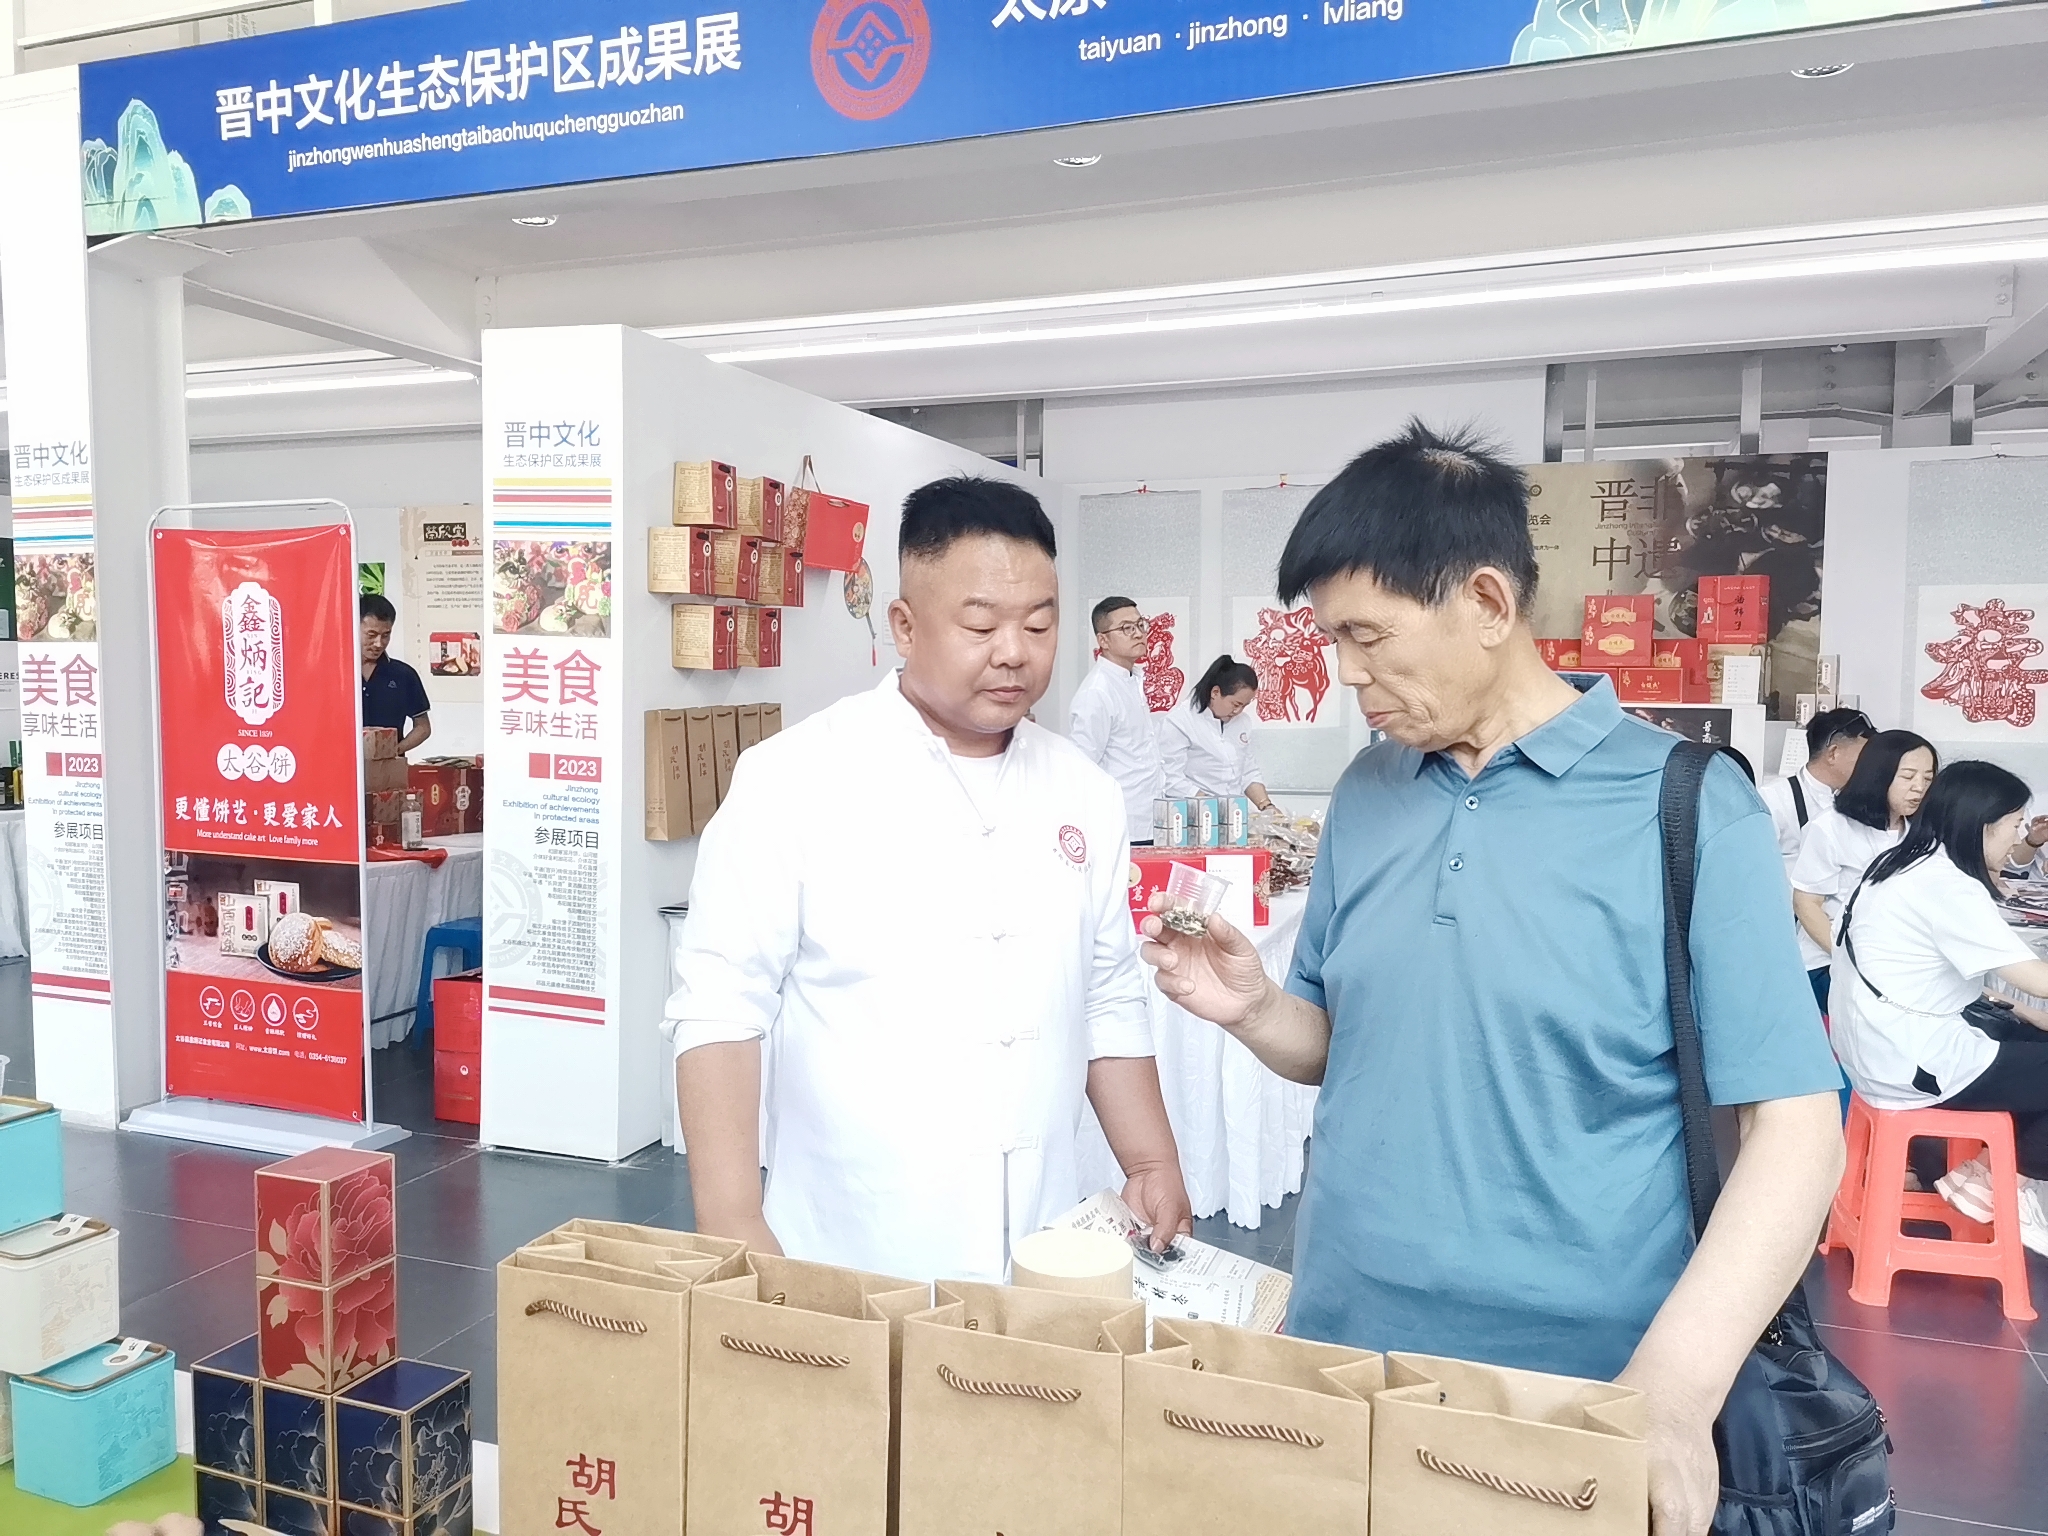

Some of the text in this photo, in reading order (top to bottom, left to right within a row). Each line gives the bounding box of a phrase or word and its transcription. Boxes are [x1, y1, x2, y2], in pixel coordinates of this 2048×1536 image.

[1079, 31, 1161, 62] taiyuan
[1186, 13, 1288, 50] jinzhong
[215, 12, 743, 141] 晋中文化生态保护区成果展
[287, 103, 685, 172] jinzhongwenhuashengtaibaohuquchengguozhan
[504, 420, 601, 448] 晋中文化
[14, 440, 89, 469] 晋中文化
[503, 453, 602, 468] 生态保护区成果展
[14, 471, 90, 487] 生态保护区成果展
[22, 654, 98, 707] 美食
[502, 647, 602, 706] 美食
[22, 711, 98, 739] 享味生活
[237, 729, 258, 737] SINCE
[500, 708, 598, 740] 享味生活
[68, 757, 99, 773] 2023
[222, 749, 291, 776] 太谷饼
[558, 759, 597, 776] 2023
[80, 792, 103, 800] ecology
[565, 785, 599, 795] Jinzhong
[571, 796, 601, 805] ecology
[502, 800, 538, 809] Exhibition
[549, 804, 600, 814] achievements
[542, 813, 577, 822] protected
[54, 821, 104, 840] 参展项目
[196, 829, 319, 847] More understand cake art Love family more
[534, 826, 599, 849] 参展项目
[556, 1453, 617, 1536] 胡氏
[759, 1490, 814, 1536] 胡
